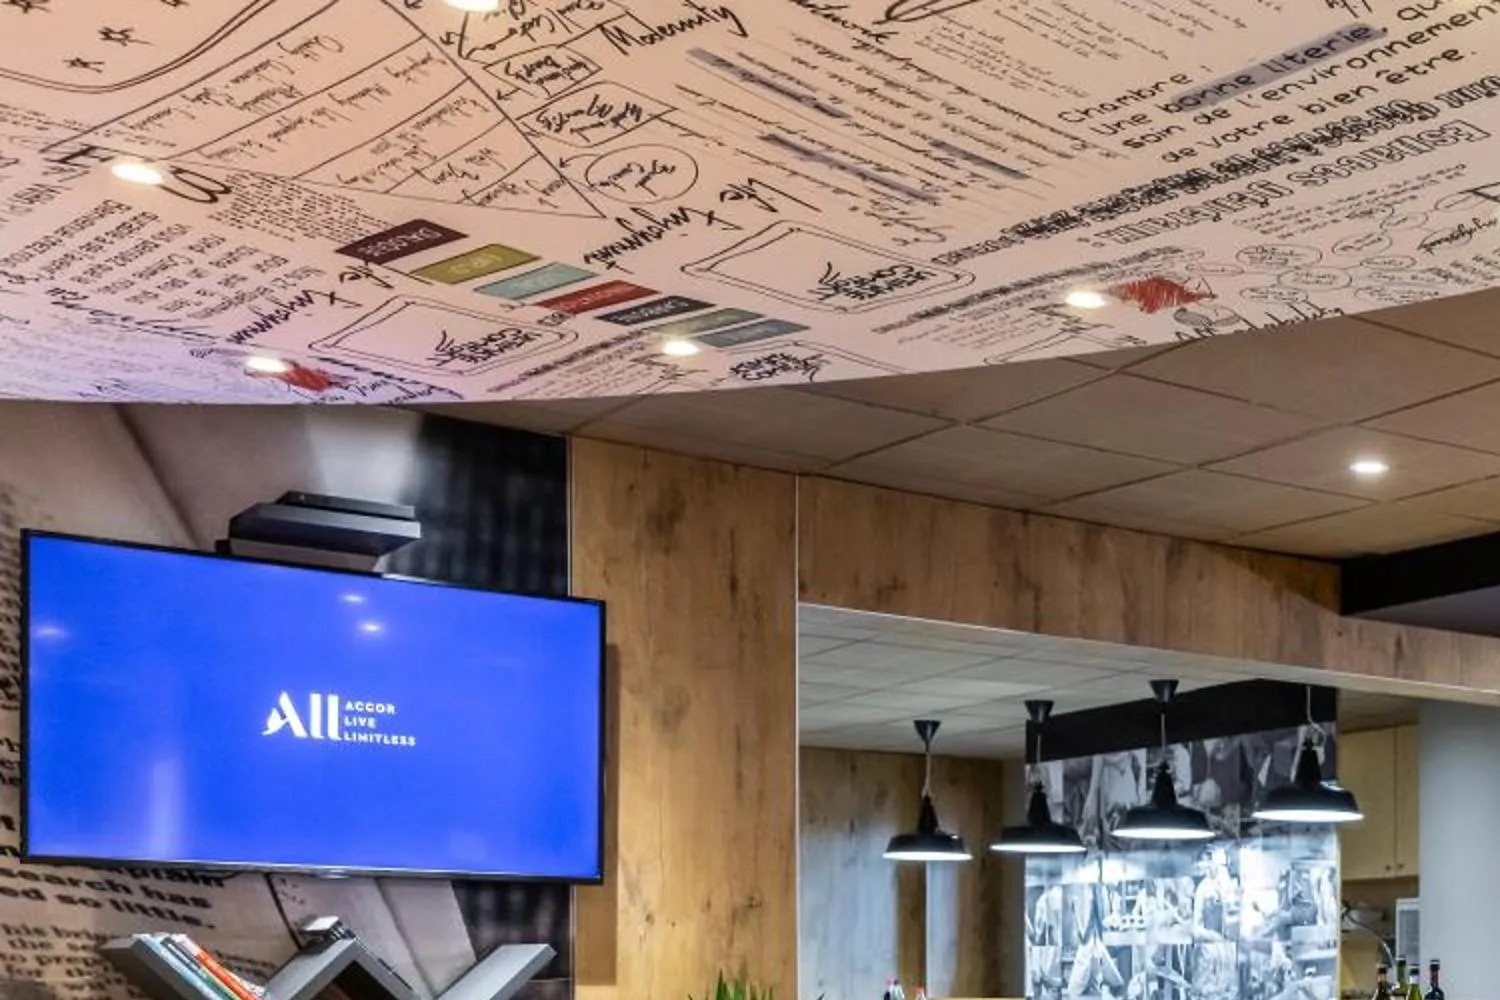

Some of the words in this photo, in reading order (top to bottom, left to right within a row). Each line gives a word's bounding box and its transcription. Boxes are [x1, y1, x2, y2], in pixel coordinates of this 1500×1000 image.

[1057, 72, 1193, 124] Chambre
[1090, 112, 1153, 137] Une
[1163, 73, 1256, 116] bonne
[1122, 123, 1187, 151] soin
[1193, 106, 1233, 127] de
[1160, 144, 1199, 164] de
[1199, 112, 1296, 150] votre
[1299, 82, 1381, 116] bien
[582, 205, 742, 274] Enjoyment
[344, 717, 377, 728] LIVE
[345, 701, 397, 715] ACCOR
[343, 731, 418, 748] LIMITLESS
[54, 893, 102, 908] so
[140, 882, 215, 909] has
